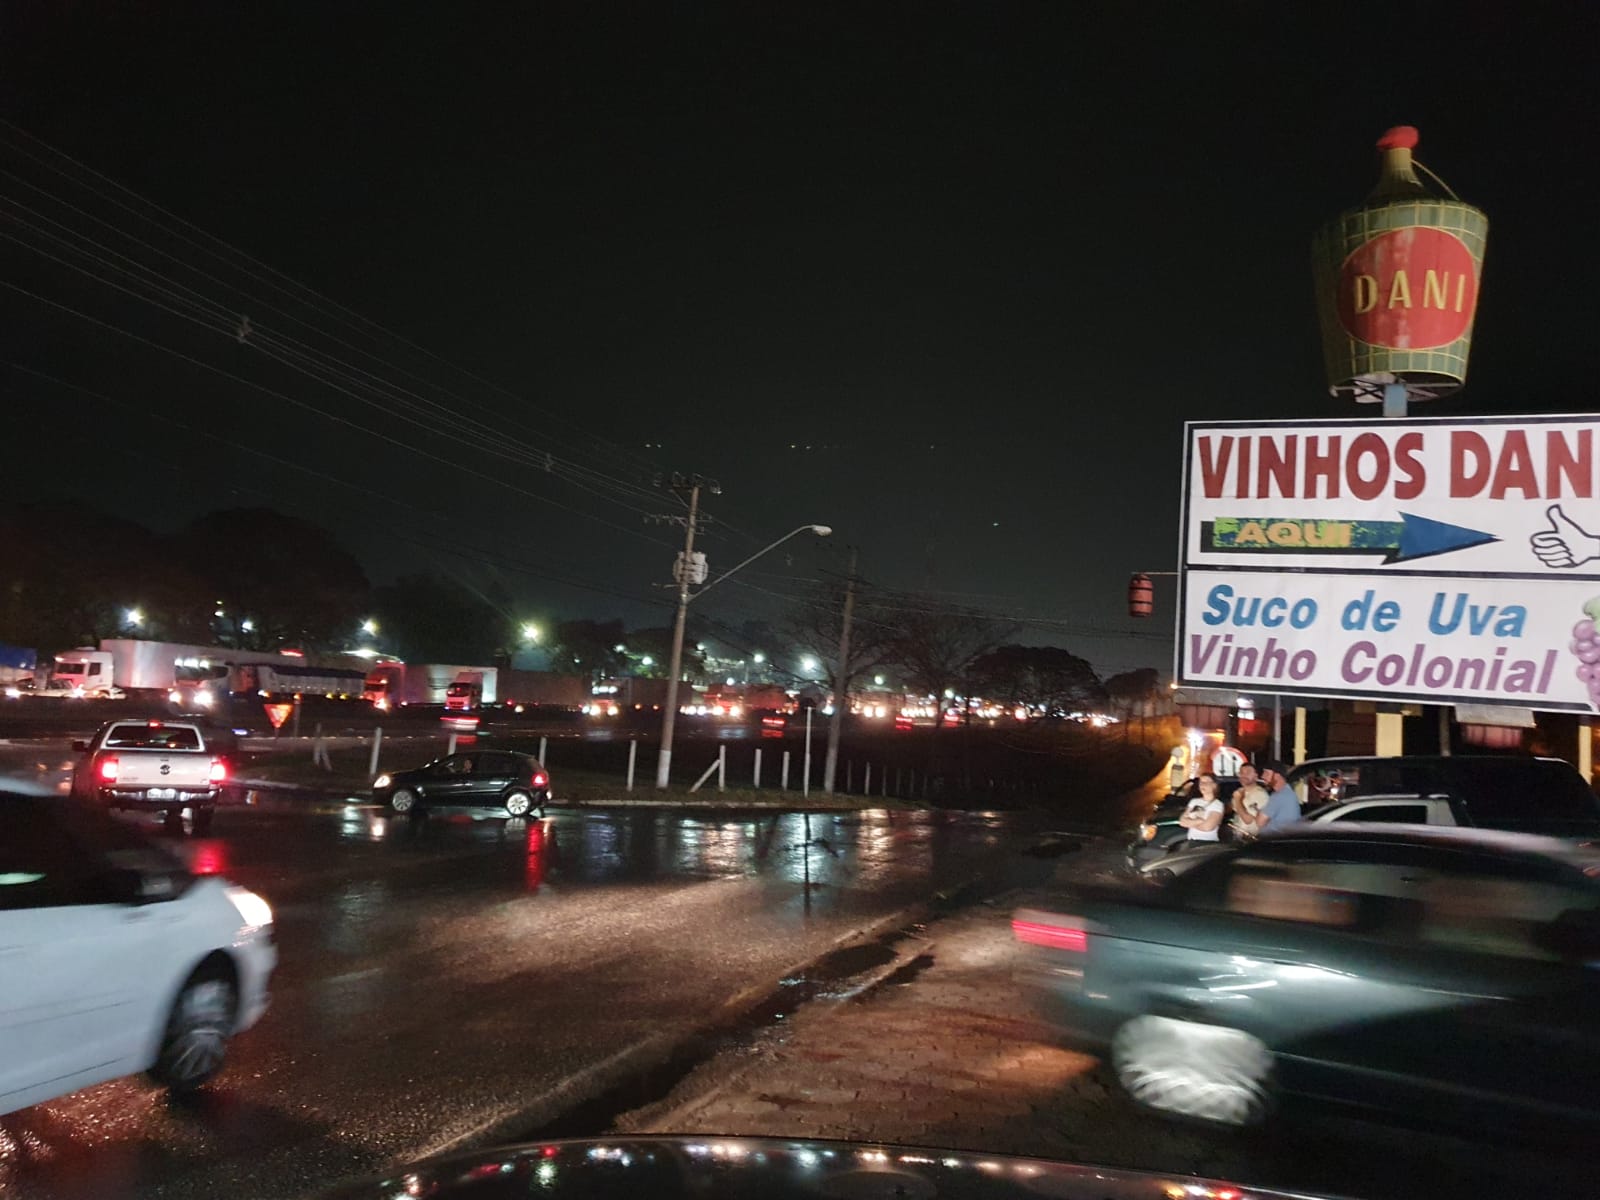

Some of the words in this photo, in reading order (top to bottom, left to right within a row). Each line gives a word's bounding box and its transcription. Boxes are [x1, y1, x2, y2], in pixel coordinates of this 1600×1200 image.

[1354, 269, 1465, 313] DANI
[1198, 432, 1426, 500] VINHOS
[1450, 429, 1593, 500] DAN
[1235, 521, 1352, 545] AQUI
[1202, 584, 1318, 628] Suco
[1341, 590, 1401, 633] de
[1428, 592, 1527, 638] Uva
[1190, 634, 1318, 681] Vinho
[1340, 640, 1558, 695] Colonial
